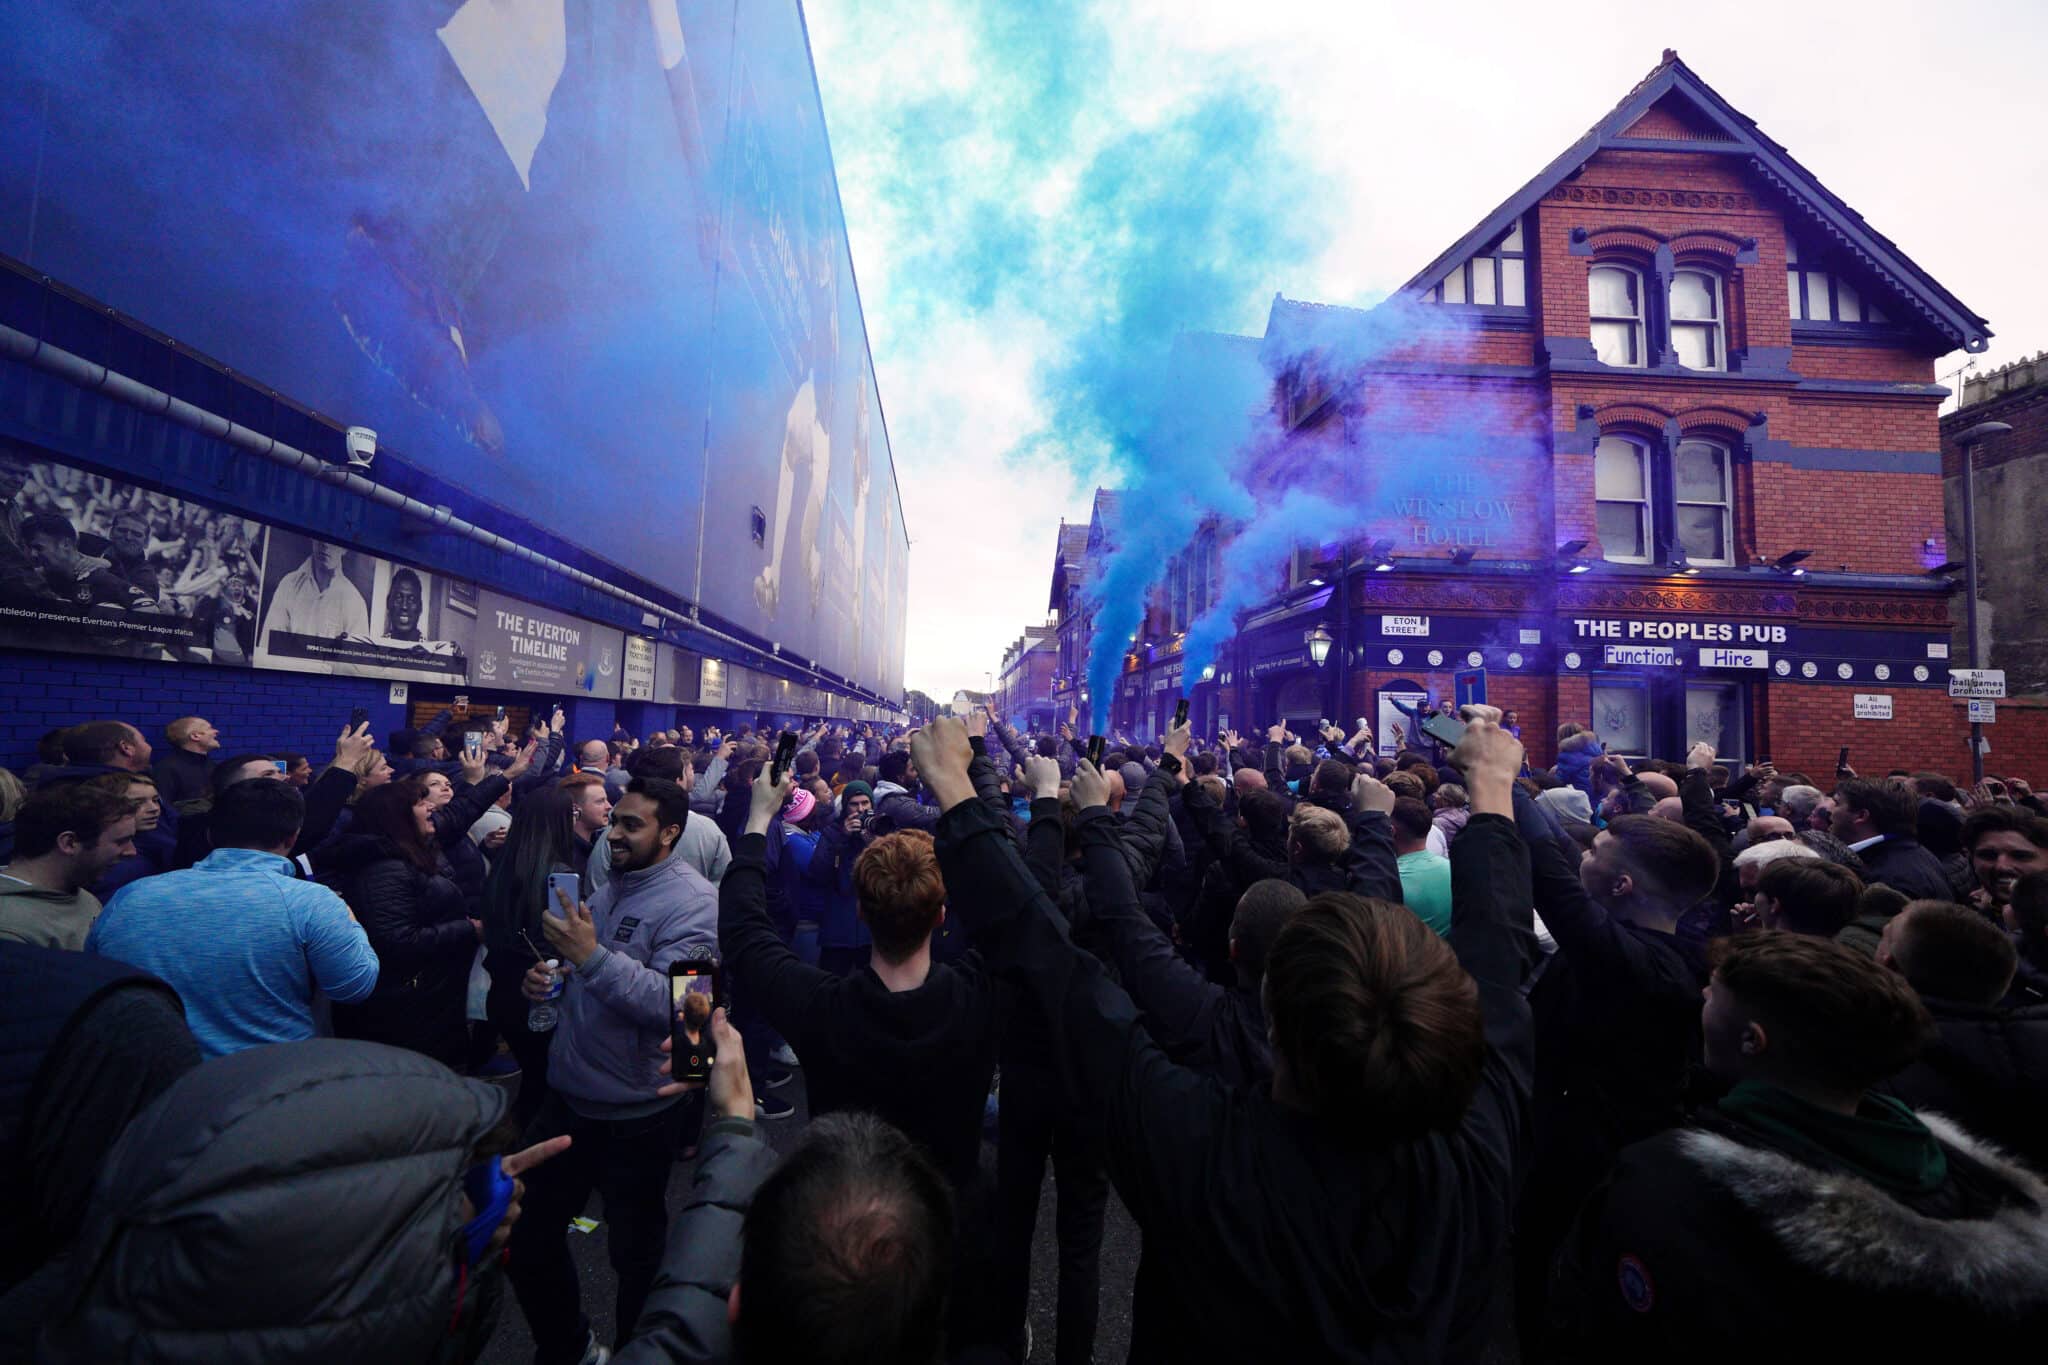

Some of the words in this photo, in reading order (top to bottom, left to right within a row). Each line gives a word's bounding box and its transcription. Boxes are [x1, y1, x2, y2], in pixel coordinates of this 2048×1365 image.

[1393, 497, 1517, 521] WINSLOW
[1412, 525, 1497, 547] HOTEL
[38, 612, 81, 623] preserves
[82, 616, 118, 628] Everton's
[119, 621, 147, 632] Premier
[495, 610, 524, 633] THE
[527, 618, 580, 646] EVERTON
[1384, 625, 1417, 634] STREET
[1393, 617, 1417, 625] ETON
[1574, 619, 1622, 638] THE
[1628, 621, 1733, 641] PEOPLES
[1739, 624, 1787, 643] PUB
[510, 635, 568, 661] TIMELINE
[1605, 646, 1674, 666] Function
[1713, 649, 1753, 666] Hire
[1971, 671, 1984, 679] All
[1952, 687, 2002, 696] prohibited
[1973, 681, 2004, 689] games
[1855, 710, 1891, 718] prohibited
[1870, 704, 1891, 712] games
